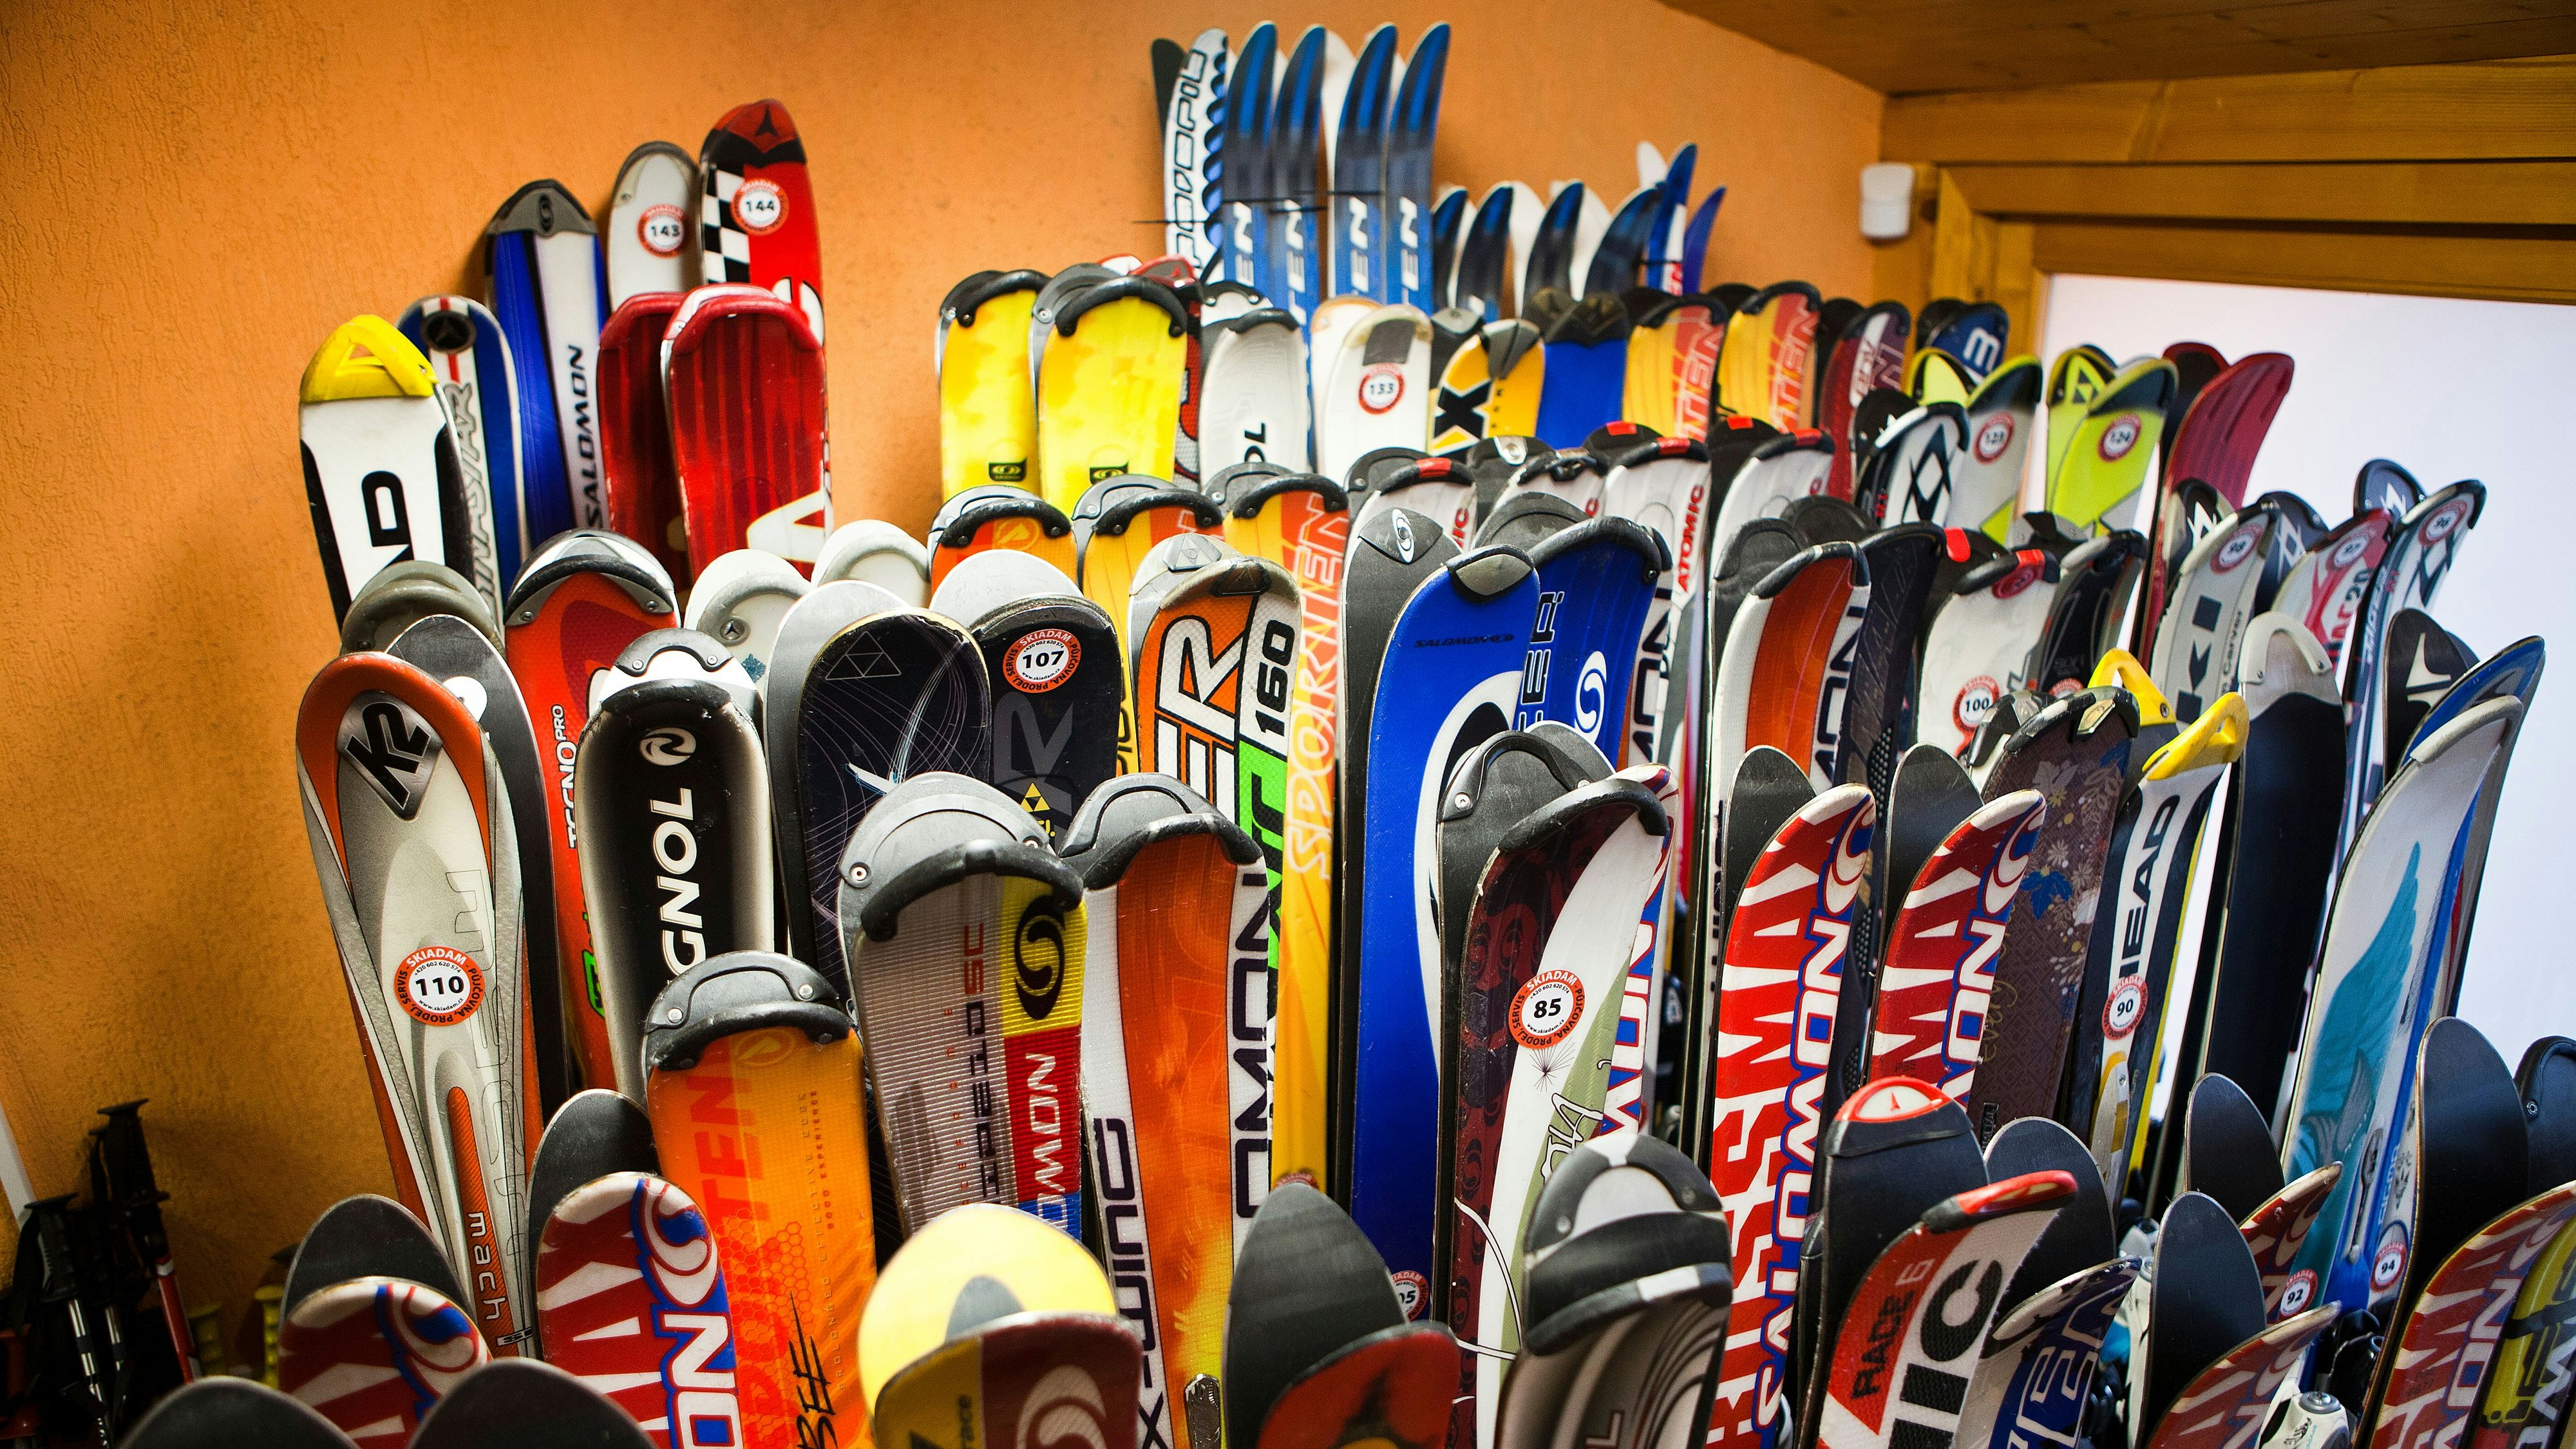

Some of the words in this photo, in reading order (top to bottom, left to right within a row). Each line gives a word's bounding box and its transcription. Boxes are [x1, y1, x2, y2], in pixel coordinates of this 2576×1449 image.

[746, 201, 775, 212] 144
[651, 225, 681, 237] 143
[1370, 383, 1394, 395] 133
[568, 343, 607, 529] SALOMON
[1678, 483, 1705, 594] ATOMIC
[1019, 630, 1072, 646] SKIADAM
[1005, 648, 1018, 676] SERVIS
[1022, 650, 1065, 669] 107
[1021, 668, 1060, 681] www.skiadam.cz
[1256, 620, 1295, 737] 160
[1966, 697, 1989, 712] 100
[549, 703, 565, 742] PRO
[406, 948, 467, 967] SKIADAM
[414, 966, 426, 976] +420
[451, 965, 461, 974] 574
[397, 970, 412, 1005] SERVIS
[415, 976, 464, 996] 110
[1526, 971, 1578, 991] SKIADAM
[1530, 988, 1542, 999] +420
[1562, 986, 1570, 994] 574
[419, 998, 464, 1011] www.skiadam.cz
[1512, 994, 1525, 1029] SERVIS
[1533, 998, 1562, 1019] 85
[2117, 998, 2134, 1017] 90
[1527, 1019, 1564, 1034] www.skiadam.cz
[1754, 918, 1852, 1428] SALOMON
[805, 1153, 829, 1262] EFFECTIVE
[468, 1211, 508, 1322] mach
[2381, 1259, 2396, 1274] 94
[2287, 1289, 2304, 1305] 92
[1850, 1289, 1915, 1400] RACE
